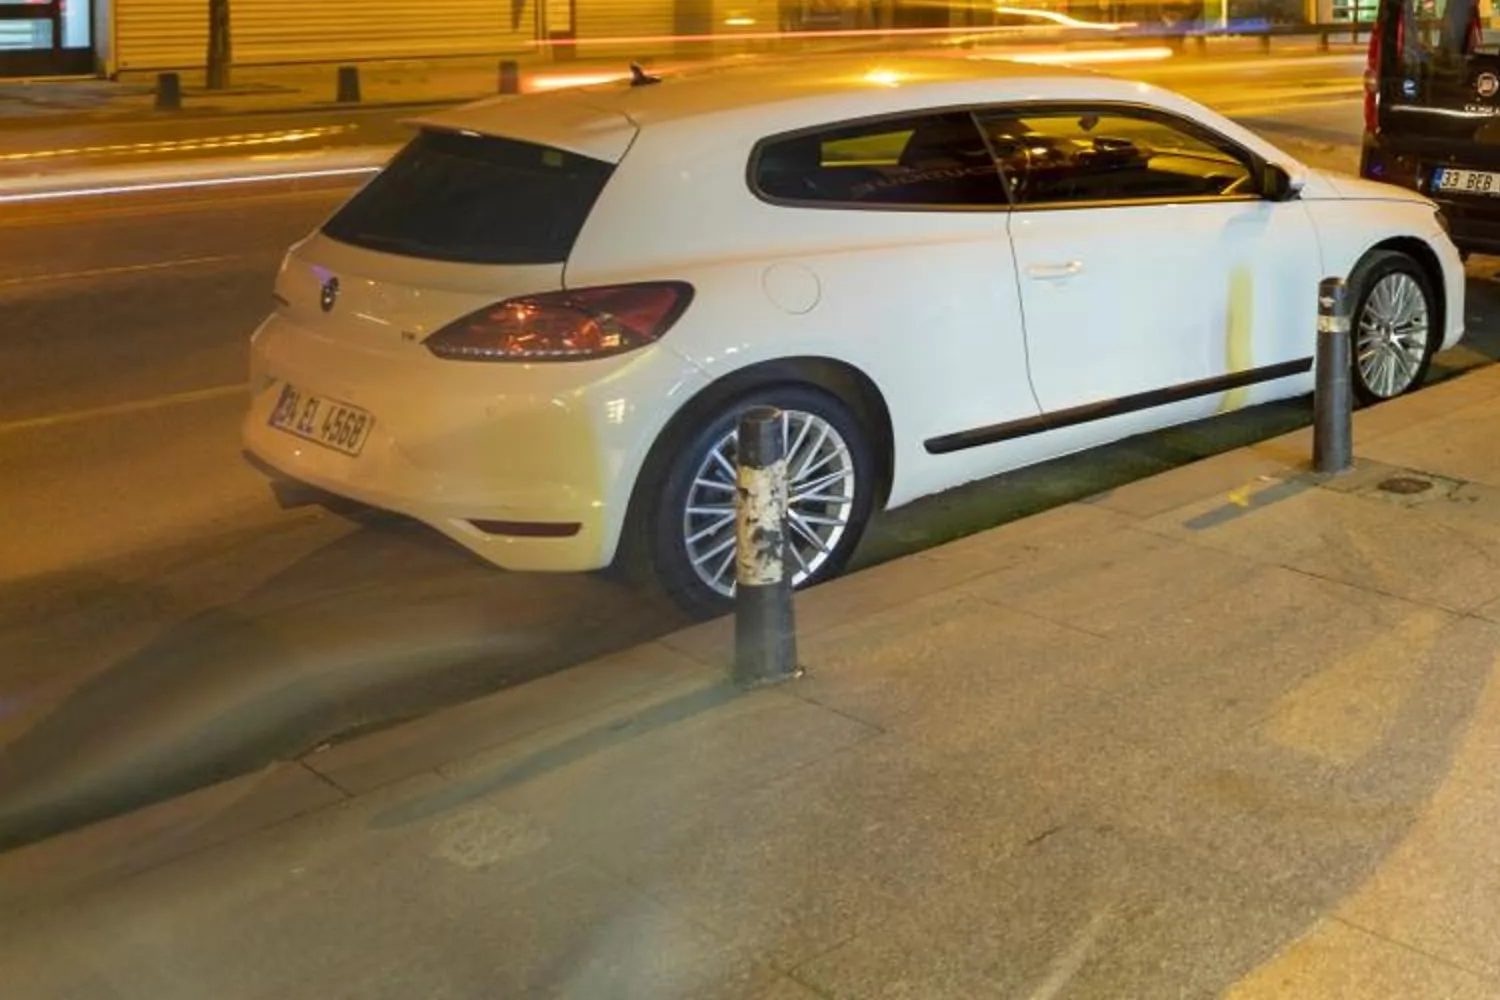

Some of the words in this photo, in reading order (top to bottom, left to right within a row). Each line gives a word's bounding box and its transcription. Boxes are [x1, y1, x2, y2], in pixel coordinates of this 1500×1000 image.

[1441, 170, 1459, 187] 33
[1466, 172, 1493, 191] BEB
[321, 405, 368, 448] 4568
